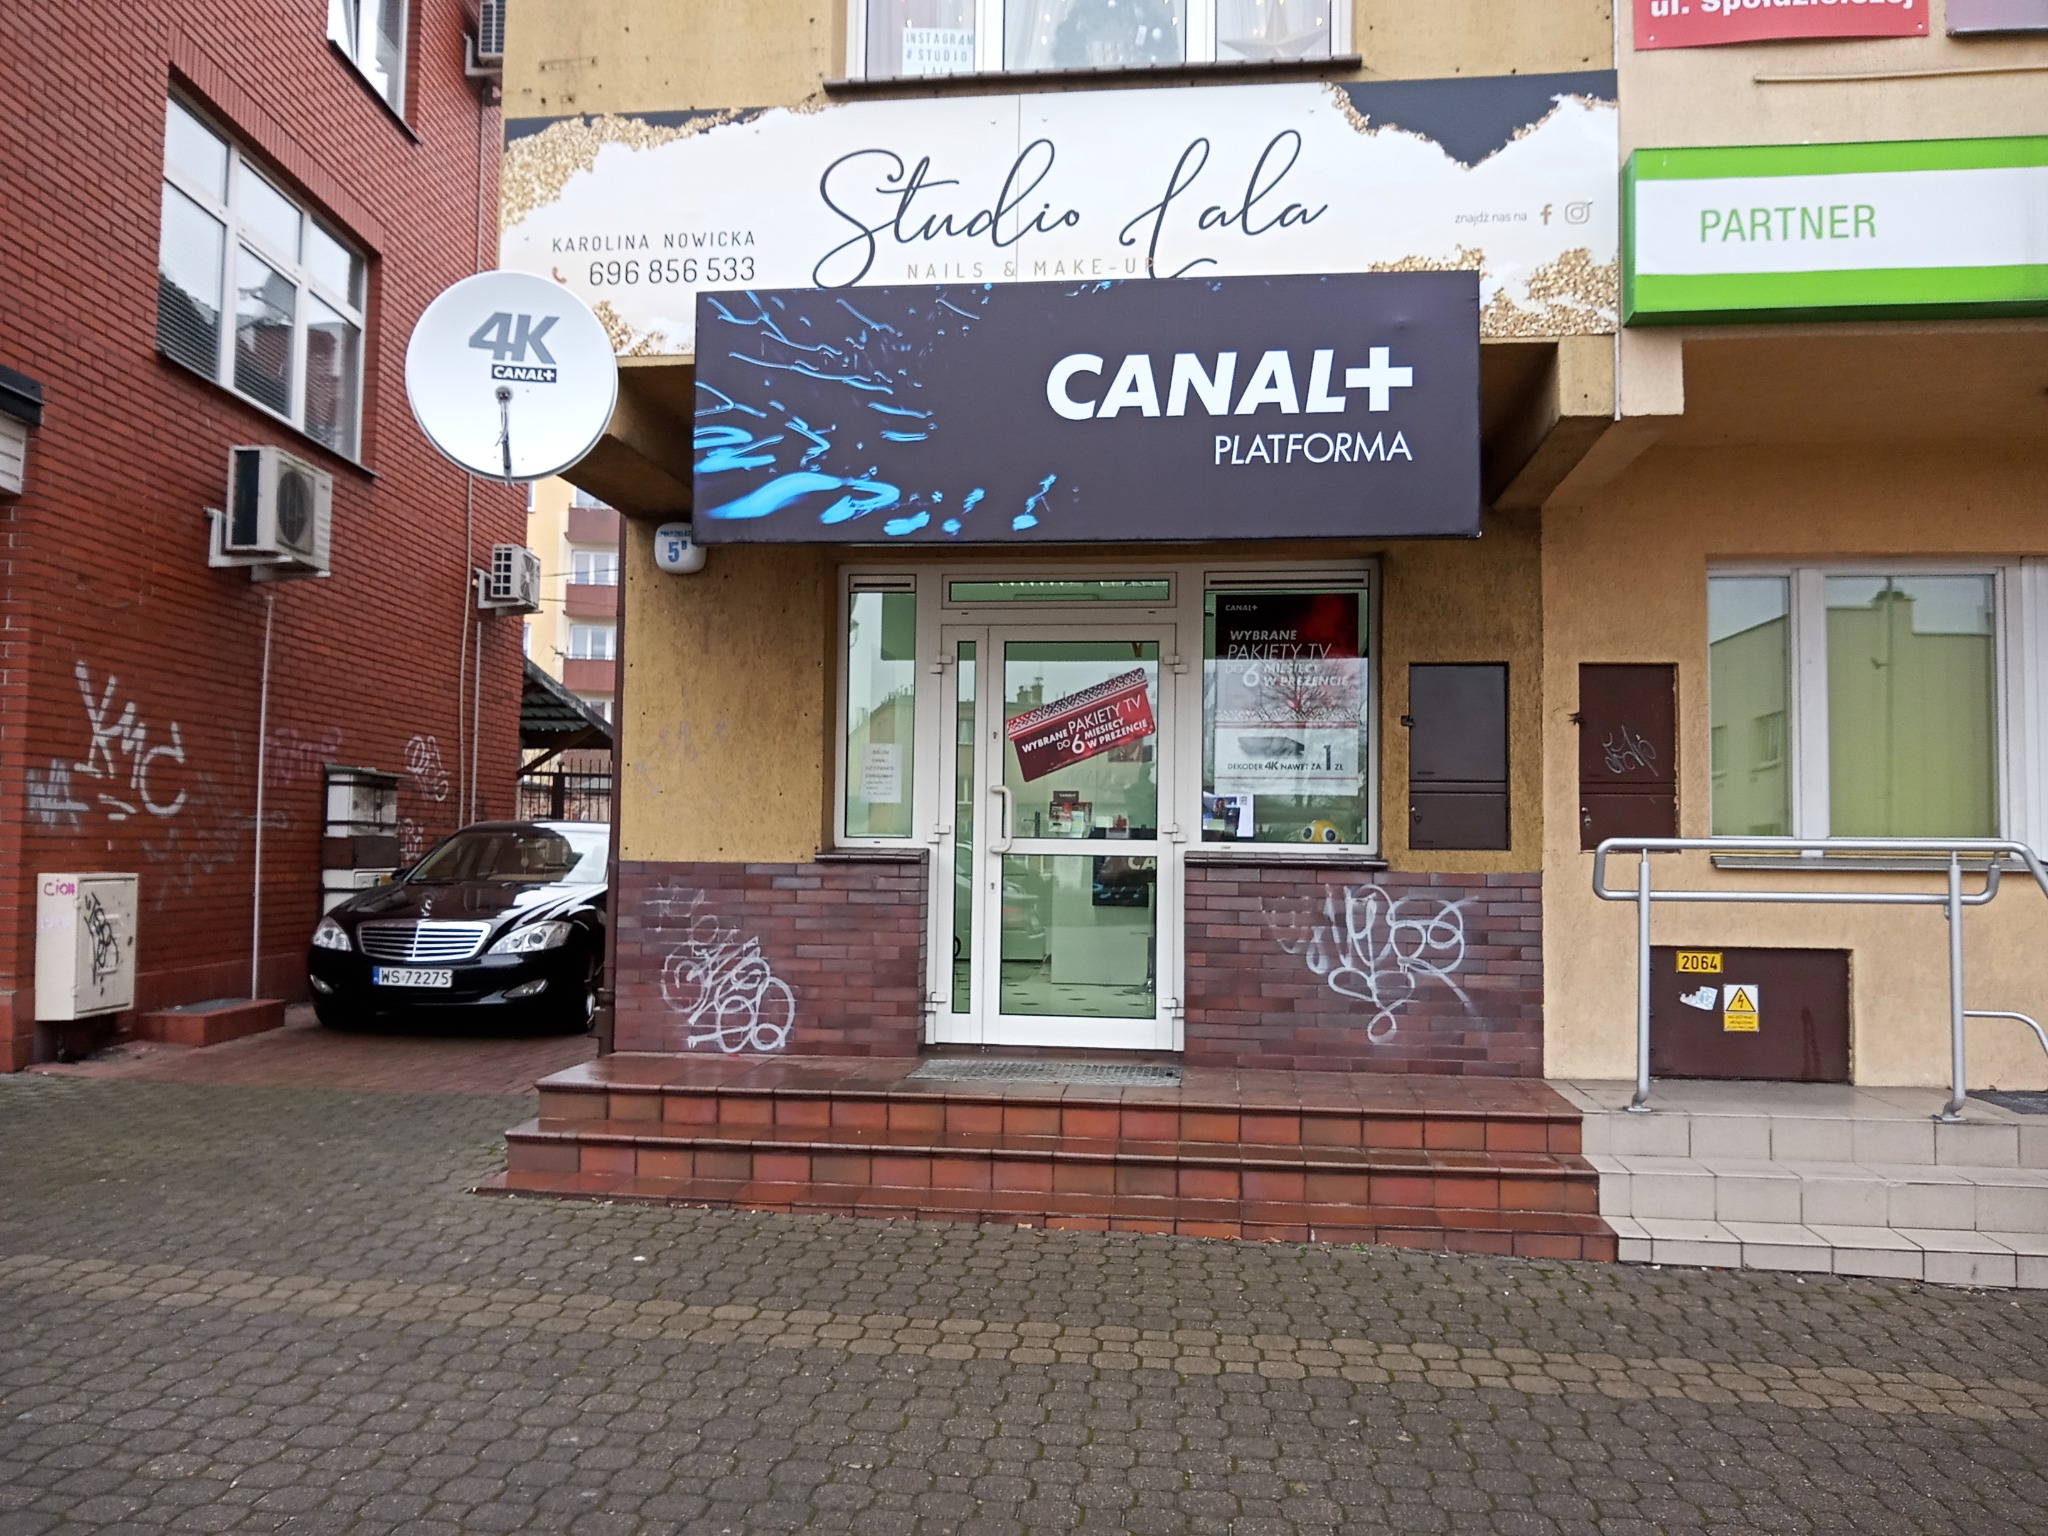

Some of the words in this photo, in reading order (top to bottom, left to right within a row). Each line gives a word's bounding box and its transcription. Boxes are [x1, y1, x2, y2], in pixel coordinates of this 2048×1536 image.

[918, 48, 967, 62] STUDIO
[813, 139, 1080, 287] Studio
[1492, 212, 1511, 223] nas
[1513, 211, 1528, 222] na
[1700, 204, 1877, 243] PARTNER
[552, 234, 650, 253] KAROLINA
[664, 231, 755, 248] NOWICKA
[589, 260, 640, 286] 696
[649, 258, 698, 284] 856
[706, 256, 755, 282] 533
[907, 261, 984, 280] NAILS
[1003, 260, 1016, 278] &
[1033, 257, 1156, 277] MAKE-UP
[468, 311, 561, 365] 4K
[493, 365, 557, 383] CANAL+
[1046, 346, 1413, 420] CANAL+
[1214, 431, 1413, 465] PLATFORMA
[1225, 604, 1258, 612] CANAL+
[1230, 630, 1298, 641] WYBRANE
[1227, 643, 1303, 660] PAKIETY
[1308, 643, 1332, 660] TV
[1241, 663, 1260, 688] 6
[1021, 728, 1068, 753] WYBRANE
[1068, 702, 1121, 735] PAKIETY
[1122, 694, 1142, 713] TV
[1057, 740, 1071, 751] DO
[1071, 734, 1085, 754] 6
[1086, 740, 1098, 749] W
[1227, 763, 1263, 771] DEKODER
[1264, 761, 1279, 771] 4K
[1310, 763, 1322, 771] ZA
[1322, 744, 1331, 771] 1
[1681, 955, 1718, 970] 2064
[381, 970, 400, 984] WS
[405, 970, 449, 985] 72275
